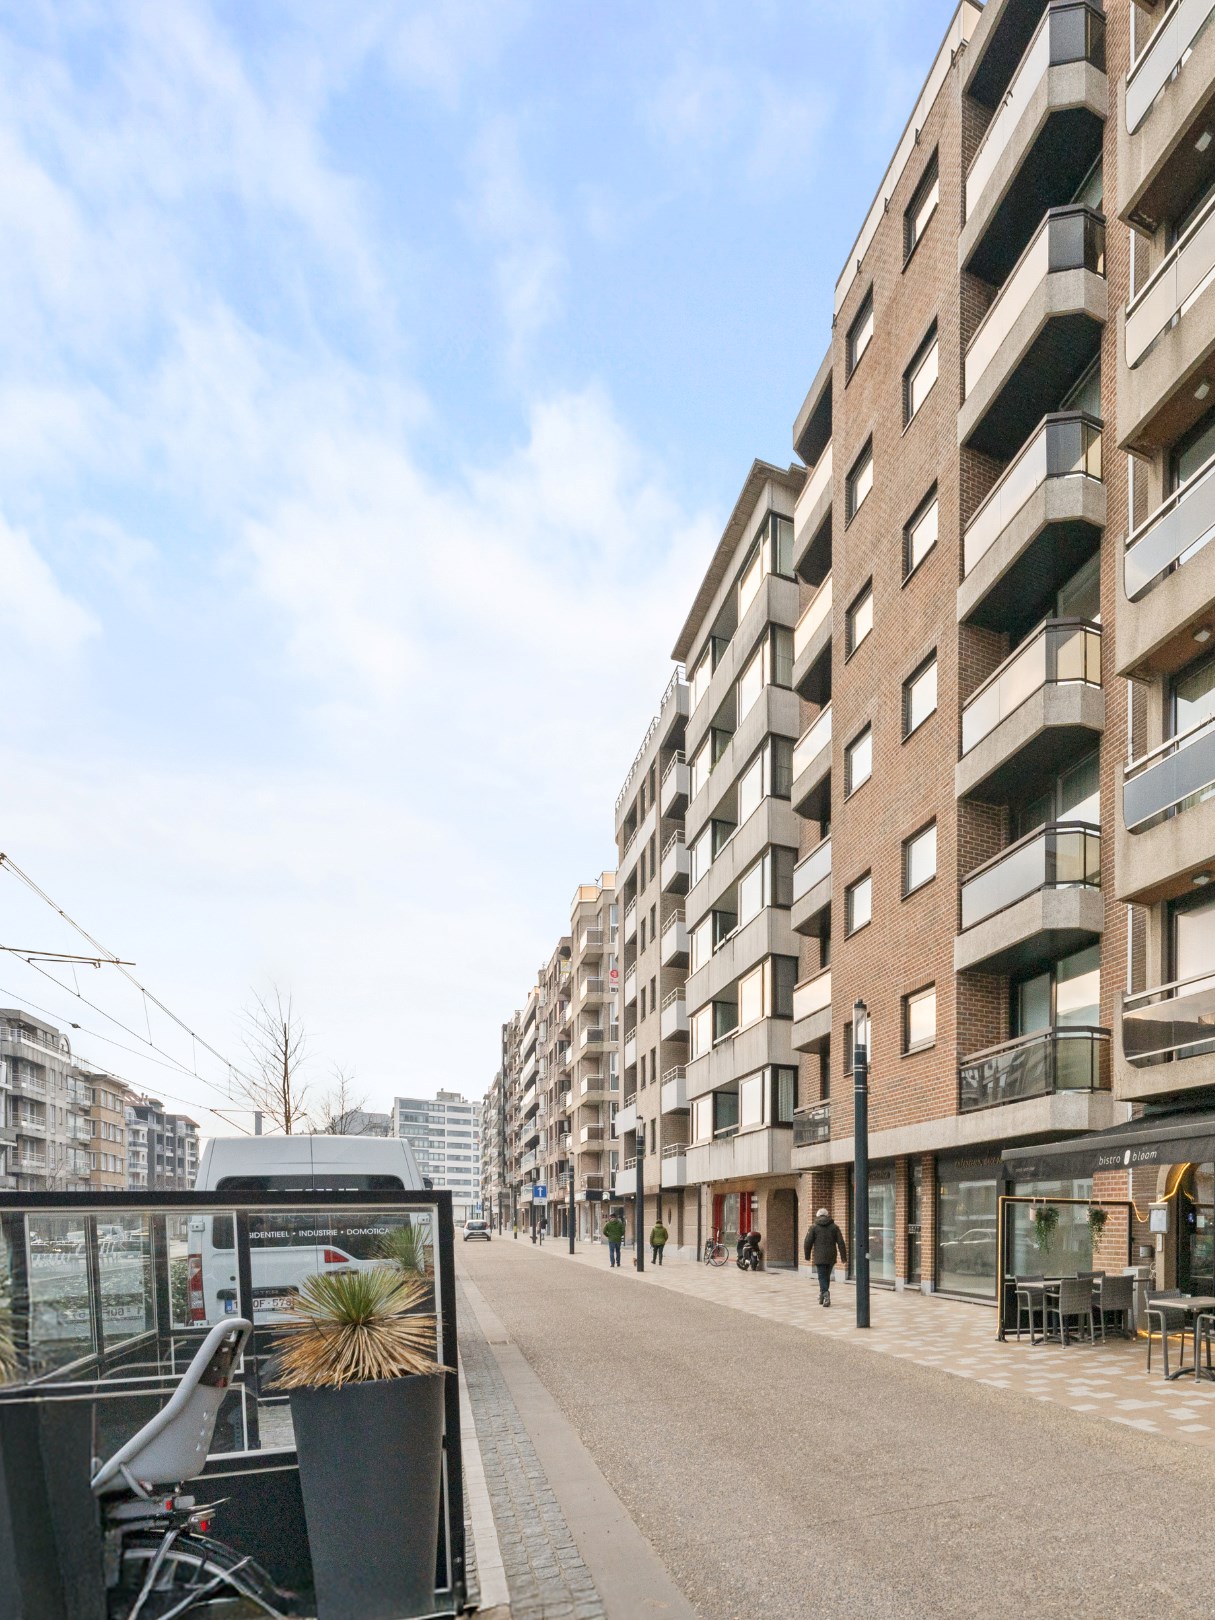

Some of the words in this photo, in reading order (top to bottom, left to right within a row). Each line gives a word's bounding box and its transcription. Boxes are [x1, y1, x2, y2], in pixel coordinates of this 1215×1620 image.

[1098, 1155, 1121, 1166] bistro
[1132, 1150, 1157, 1162] bloom
[299, 1229, 338, 1237] INDUSTRIE
